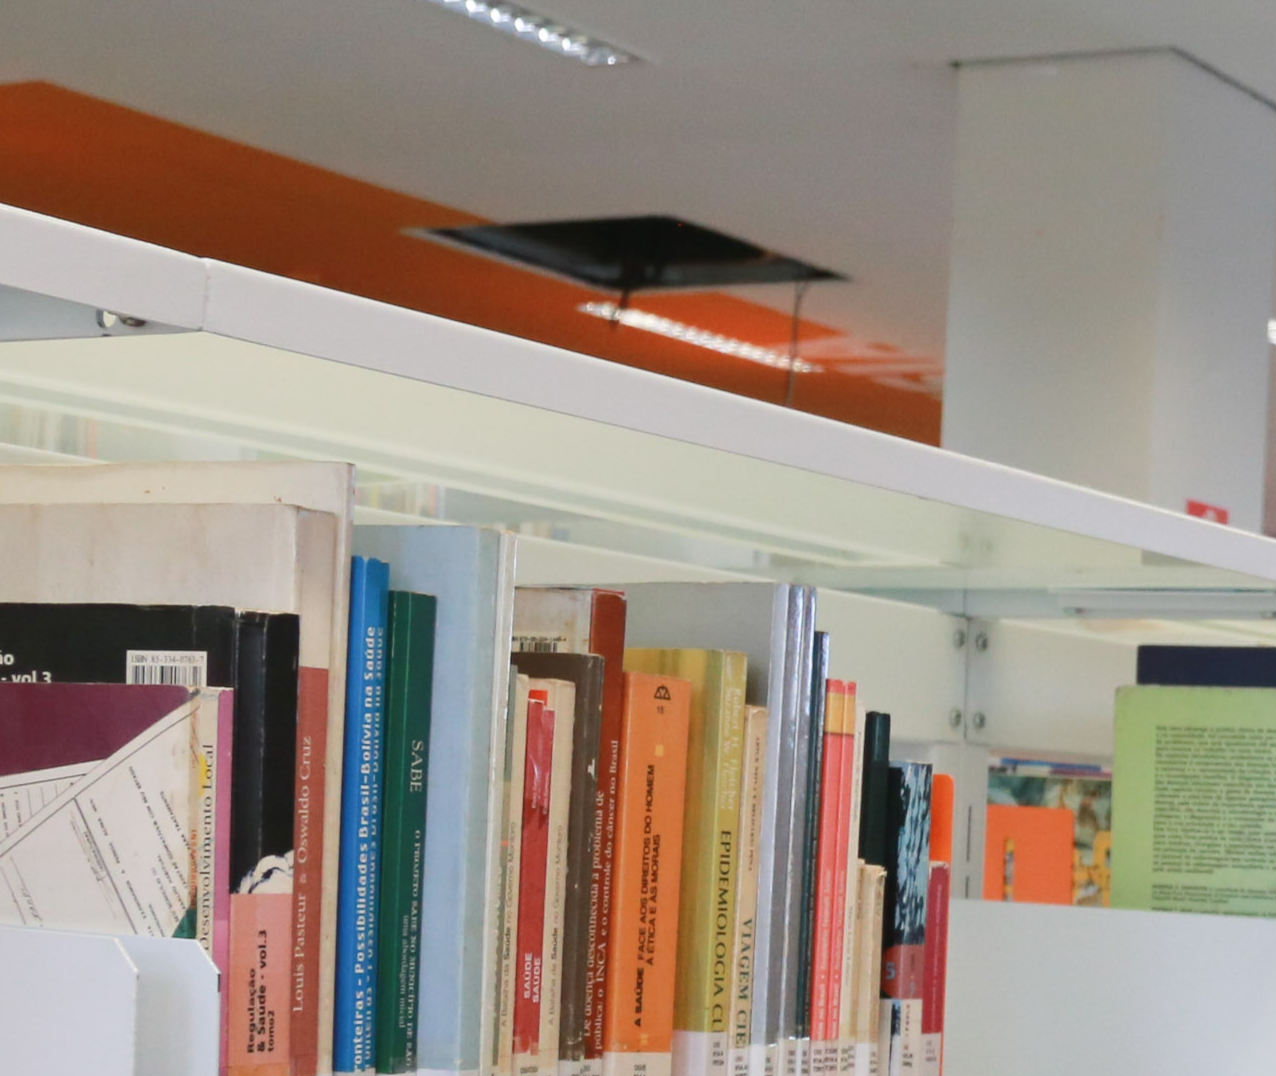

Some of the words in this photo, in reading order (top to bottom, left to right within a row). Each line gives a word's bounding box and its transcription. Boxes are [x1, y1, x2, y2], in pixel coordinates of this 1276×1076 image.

[363, 626, 375, 681] Saúde
[364, 686, 373, 708] na
[731, 688, 743, 729] Robert
[203, 744, 214, 789] Local
[299, 736, 312, 780] Cruz
[358, 712, 373, 838] Brasil-Bolívia
[409, 739, 424, 793] SABE
[609, 740, 619, 773] Brasil
[609, 777, 617, 794] no
[644, 764, 655, 812] HOMEM
[727, 758, 740, 811] Fletcher
[297, 785, 310, 863] Oswaldo
[604, 797, 615, 839] câncer
[643, 815, 652, 834] DO
[603, 841, 613, 858] do
[640, 837, 652, 894] DIREITOS
[650, 833, 661, 883] MORAIS
[198, 797, 213, 951] Desenvolvimento
[505, 866, 514, 908] Governo
[600, 862, 612, 913] controle
[294, 893, 307, 958] Pasteur
[354, 843, 369, 974] Possibilidades
[639, 897, 649, 924] AOS
[713, 829, 732, 997] EPIDEMIOLOGIA
[258, 930, 268, 969] vol.3
[502, 926, 511, 960] Saúde
[549, 927, 559, 960] Saúde
[595, 942, 607, 982] INCA
[637, 928, 648, 961] FACE
[738, 917, 753, 1001] VIAGEM
[292, 963, 305, 1012] Louis
[501, 978, 510, 1017] Batalha
[522, 952, 533, 999] SAÚDE
[633, 967, 645, 1014] SAÚDE
[246, 968, 258, 1054] Regulação
[256, 985, 268, 1036] Saúde
[267, 1010, 276, 1053] tomo2
[735, 1009, 749, 1047] CIE
[257, 1040, 267, 1053] &
